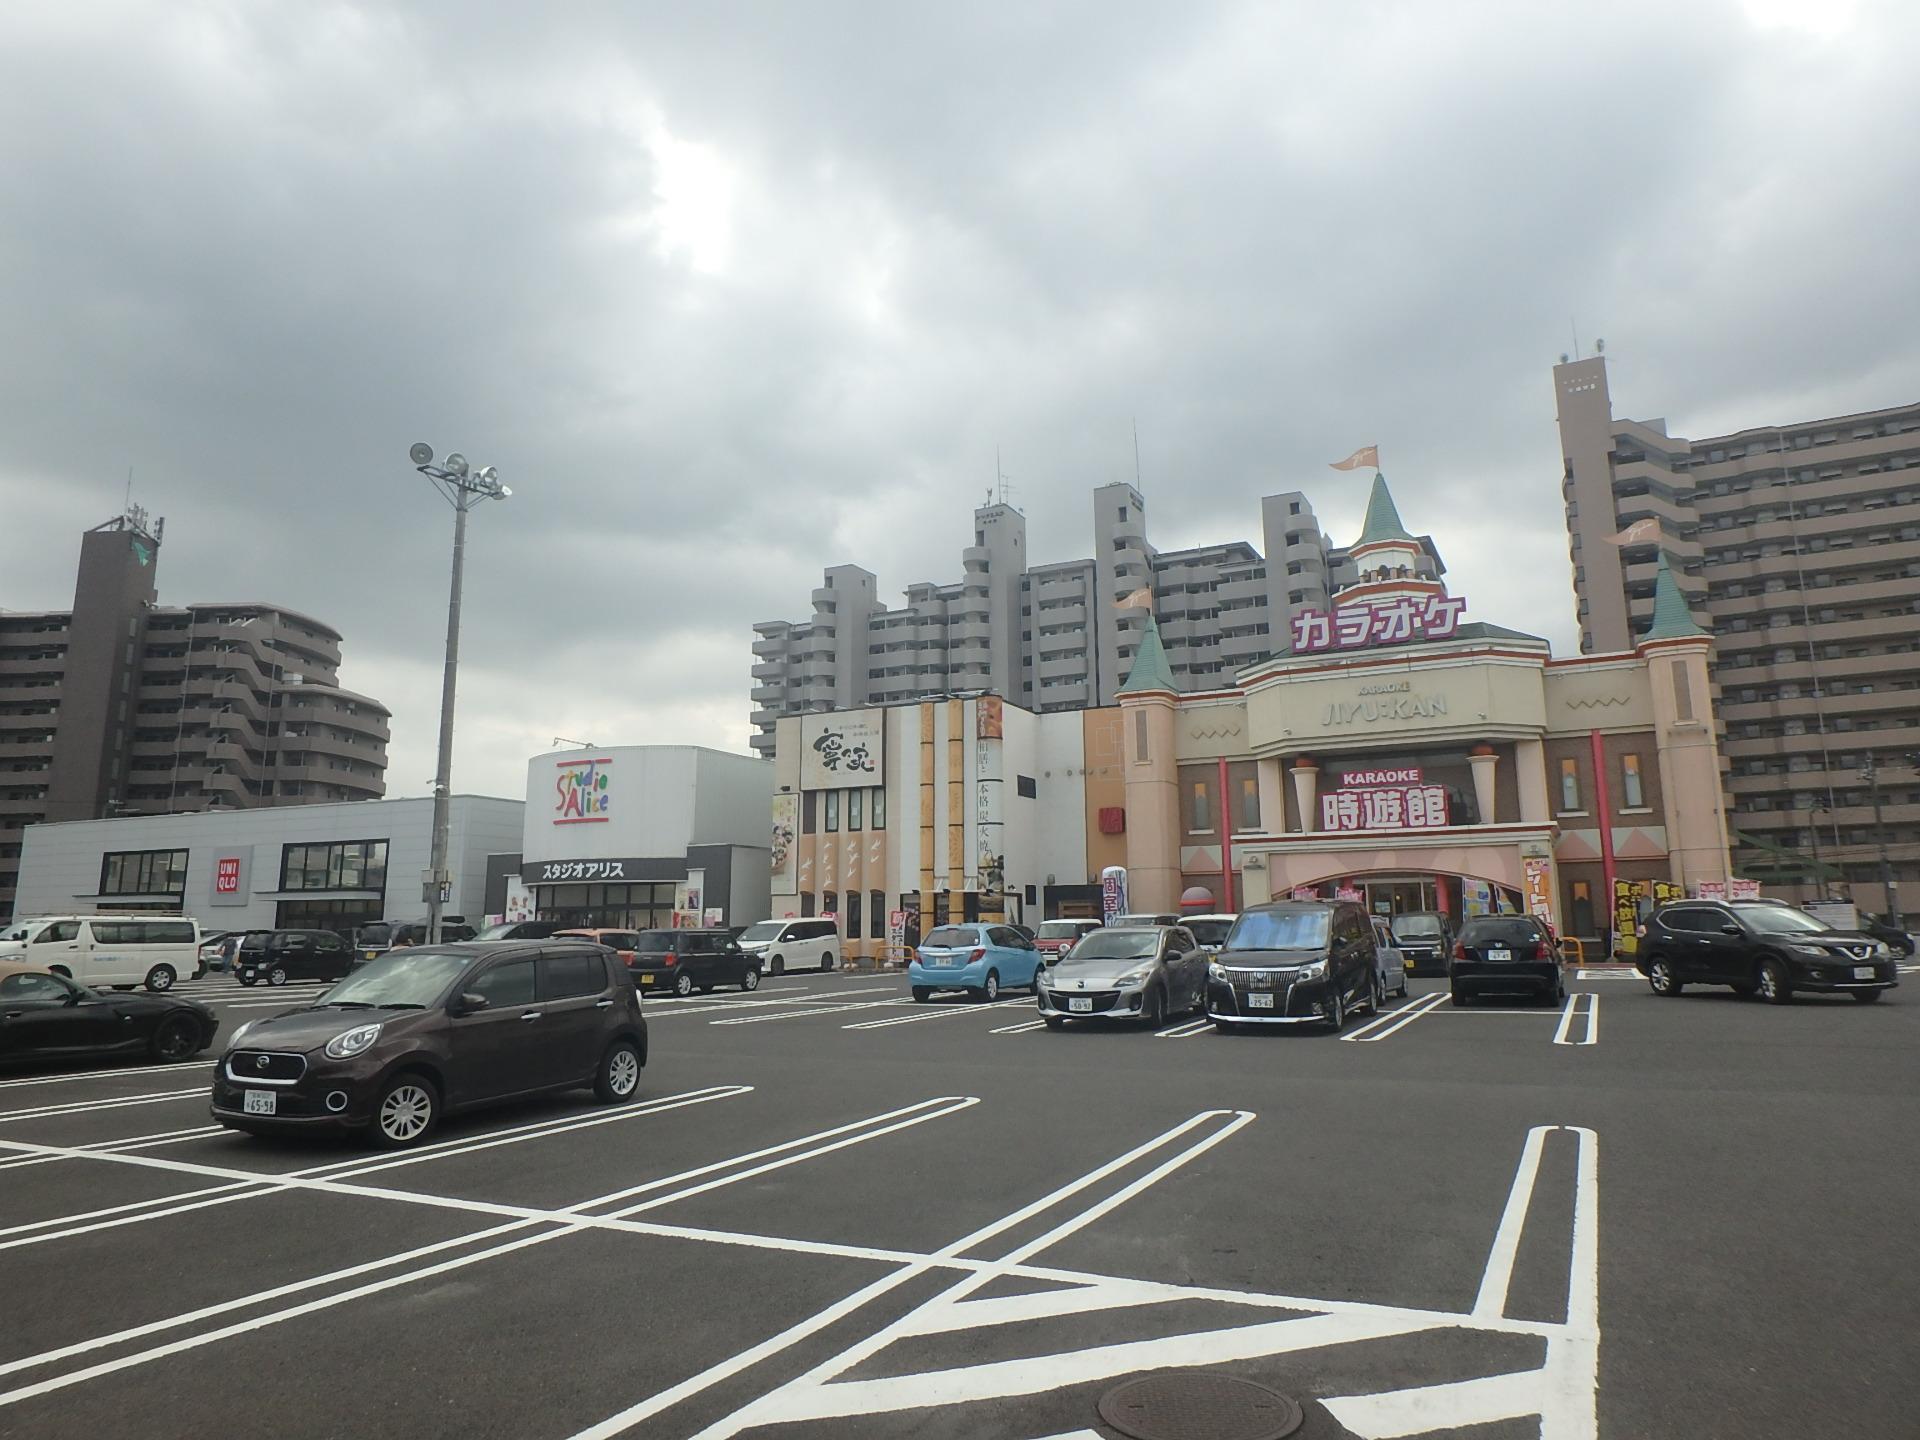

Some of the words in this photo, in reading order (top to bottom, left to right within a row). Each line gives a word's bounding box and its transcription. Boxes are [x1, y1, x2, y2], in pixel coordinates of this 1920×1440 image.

[1293, 597, 1464, 651] カラオケ
[1343, 769, 1419, 785] KARAOKE
[1322, 788, 1447, 831] 時遊館
[220, 862, 237, 875] UNI
[542, 862, 624, 880] スタジオアリス
[218, 876, 237, 890] QLO
